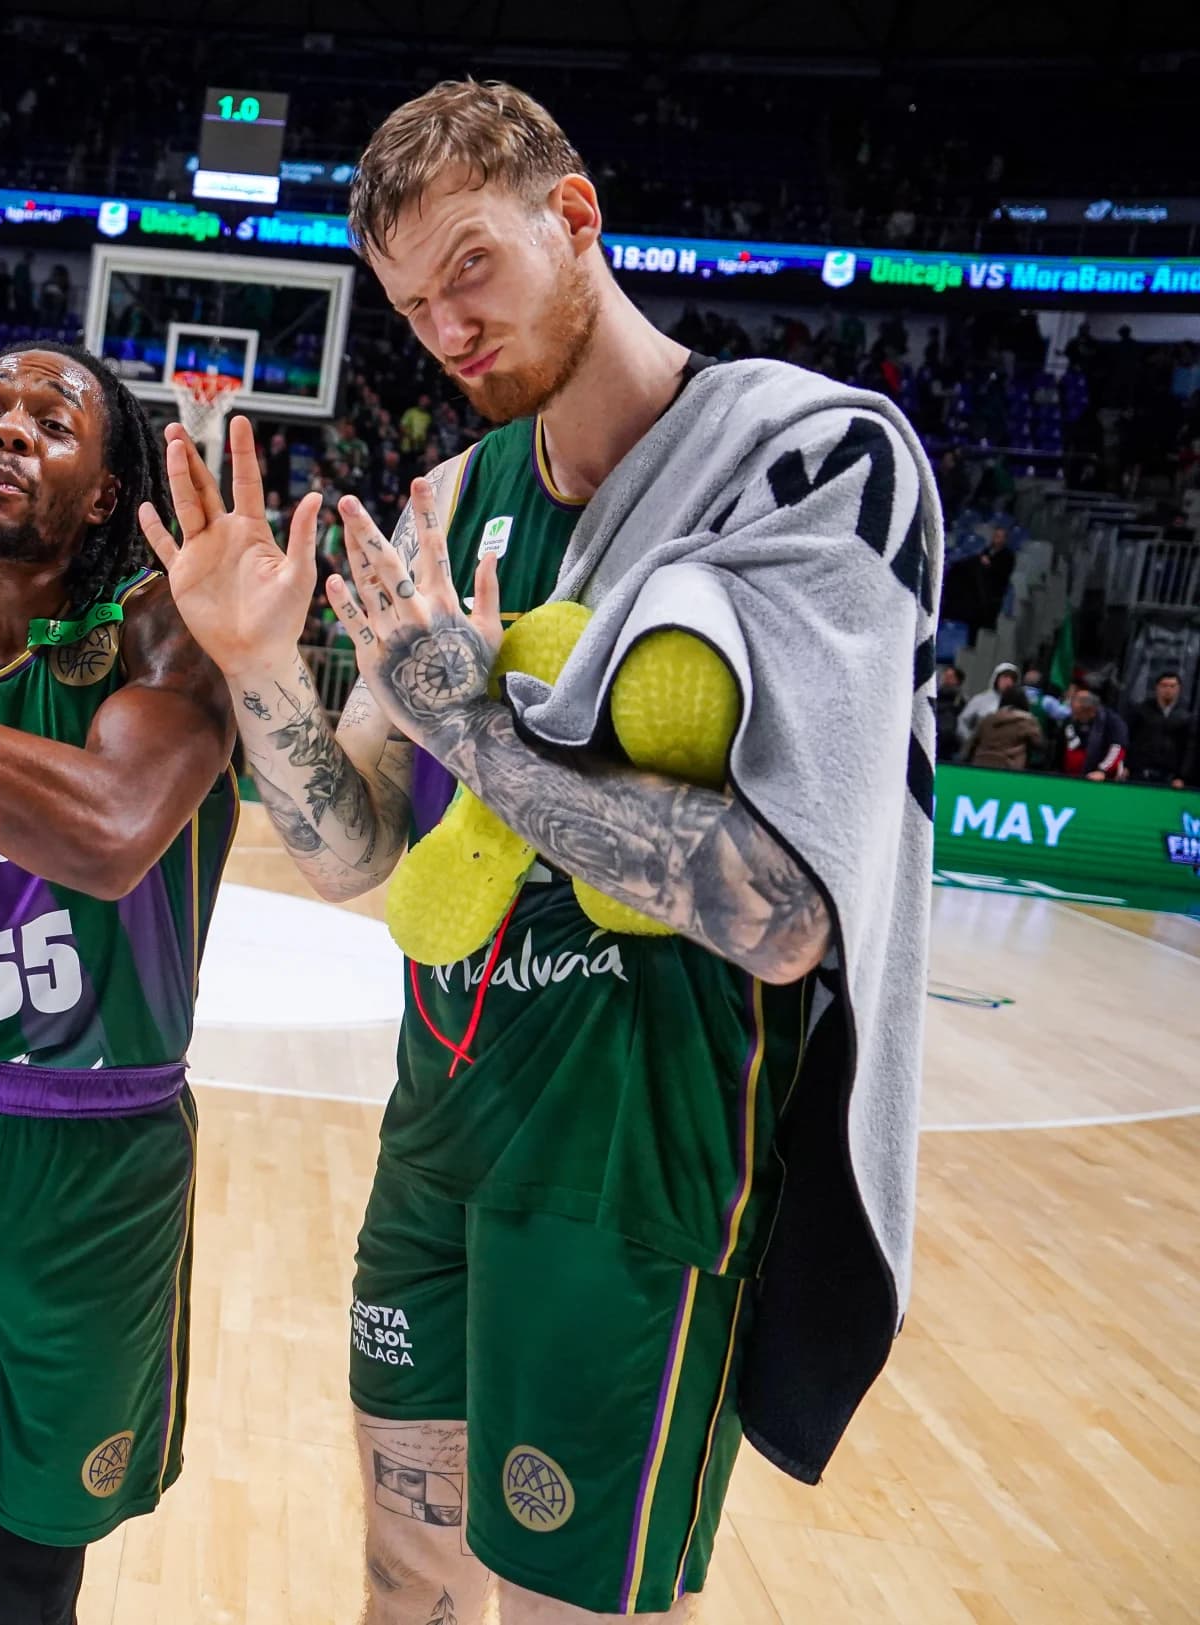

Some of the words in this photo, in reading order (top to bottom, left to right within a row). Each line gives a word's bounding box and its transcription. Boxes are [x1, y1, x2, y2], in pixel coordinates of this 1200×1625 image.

[218, 96, 260, 122] 1.0
[140, 207, 220, 242] Unicaja
[611, 244, 677, 273] 19:00
[677, 249, 697, 274] H
[870, 256, 963, 292] Unicaja
[968, 262, 1006, 290] VS
[1010, 261, 1146, 293] MoraBanc
[952, 795, 1077, 847] MAY
[352, 1331, 415, 1367] MÁLAGA
[353, 1313, 373, 1340] DEL
[374, 1327, 413, 1349] SOL
